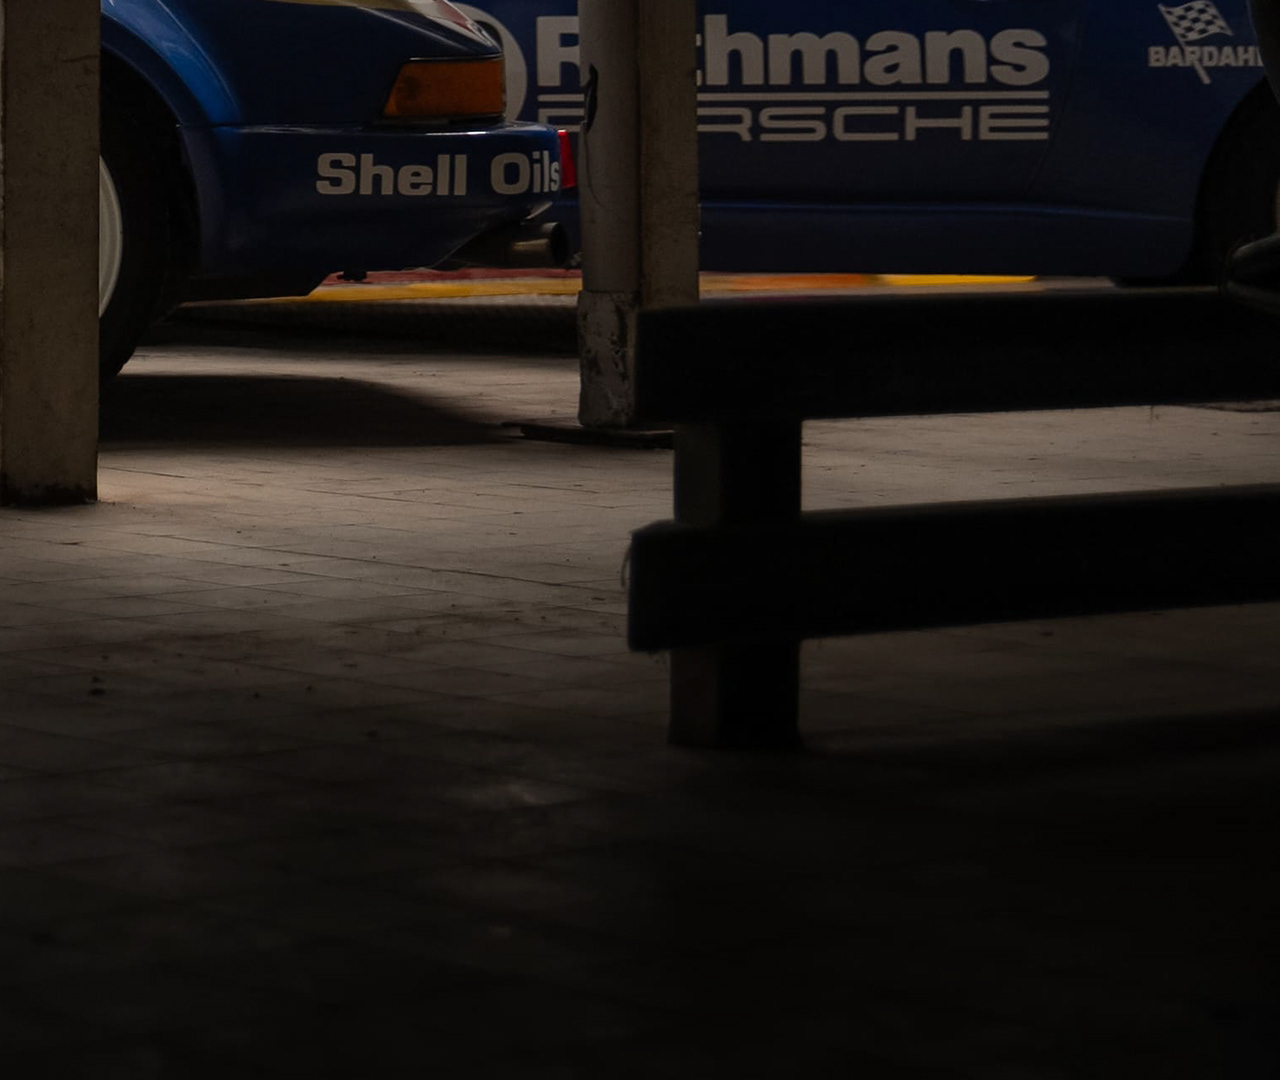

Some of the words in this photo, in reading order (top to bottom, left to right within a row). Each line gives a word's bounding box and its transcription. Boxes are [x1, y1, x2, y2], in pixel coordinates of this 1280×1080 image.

[536, 14, 1049, 86] Rhmans
[537, 106, 1049, 142] PRSCHE
[315, 152, 468, 196] Shell
[490, 150, 561, 195] Oils
